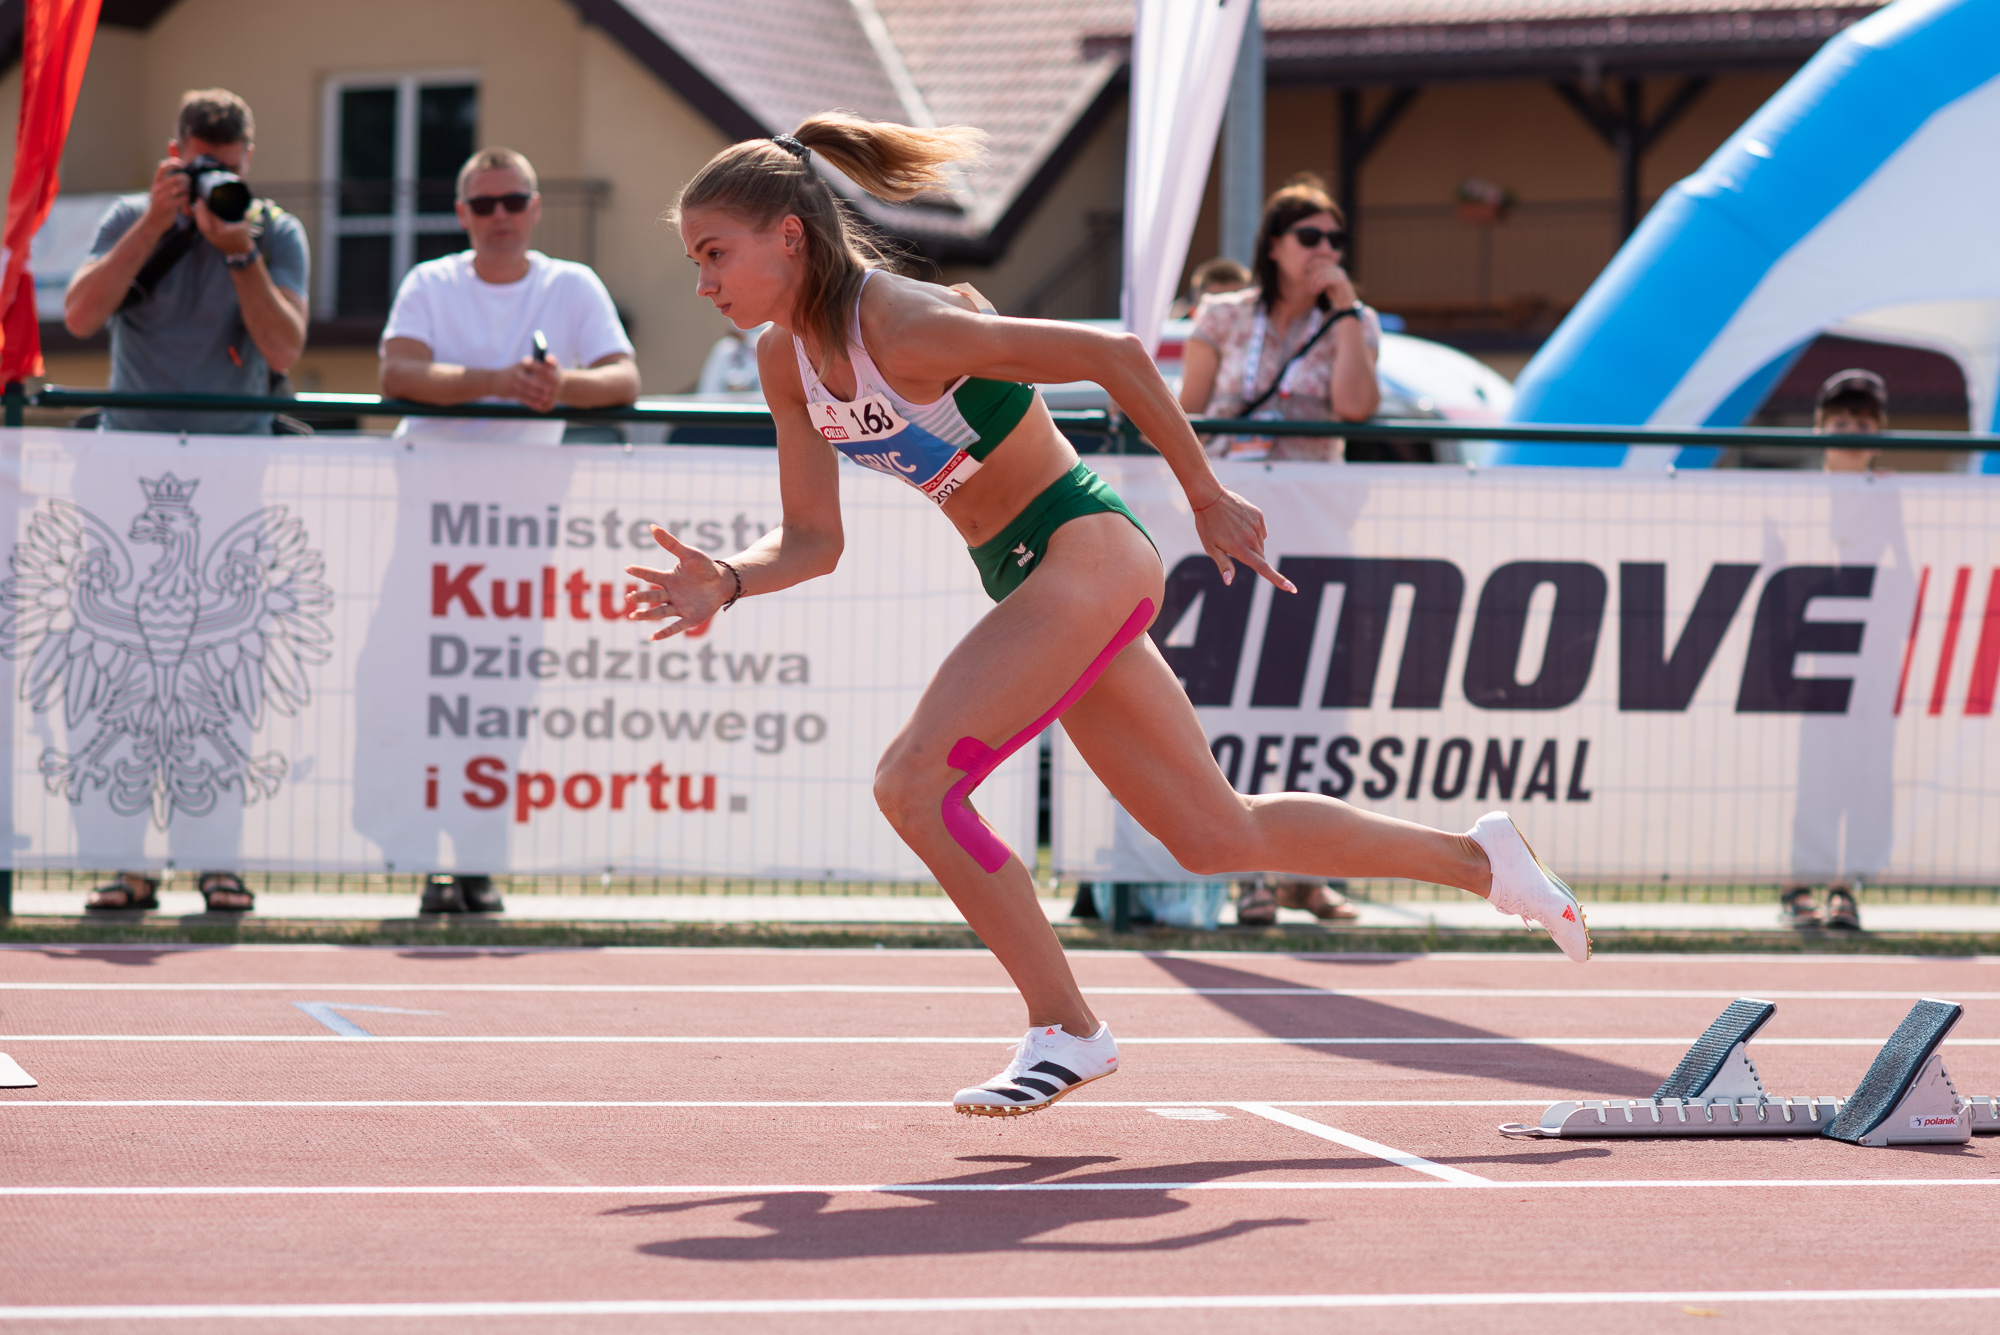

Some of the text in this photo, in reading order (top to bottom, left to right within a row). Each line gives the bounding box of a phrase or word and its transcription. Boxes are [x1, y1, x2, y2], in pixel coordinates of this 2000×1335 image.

[823, 427, 848, 438] ORLEN
[924, 470, 949, 491] POLSKI
[947, 455, 963, 471] U23
[932, 478, 963, 504] 2021
[431, 503, 783, 552] Ministerst
[431, 563, 717, 637] Kultu
[429, 634, 811, 684] Dziedzictwa
[427, 694, 828, 754] Narodowego
[424, 766, 440, 809] i
[1924, 1117, 1955, 1127] polanik
